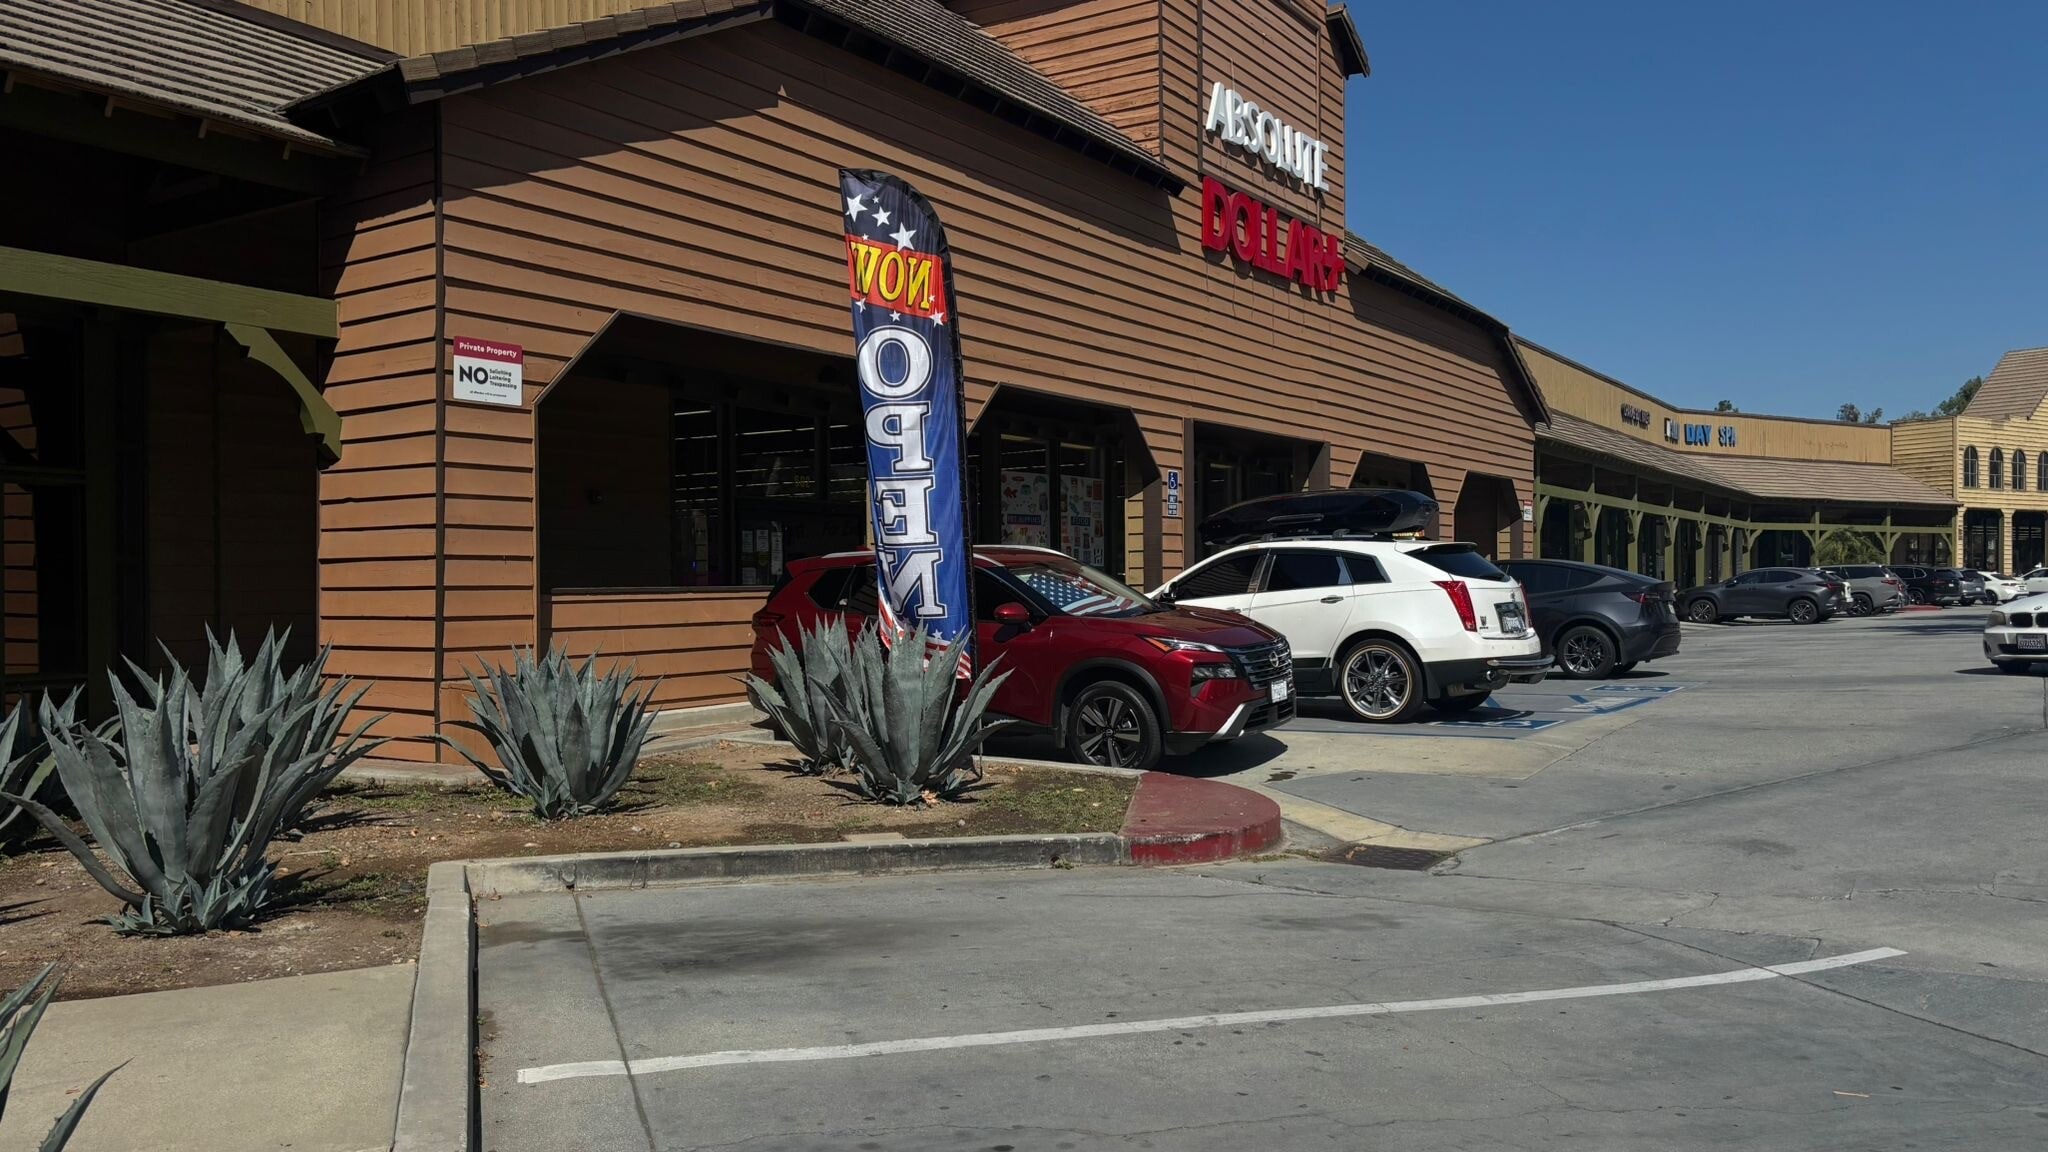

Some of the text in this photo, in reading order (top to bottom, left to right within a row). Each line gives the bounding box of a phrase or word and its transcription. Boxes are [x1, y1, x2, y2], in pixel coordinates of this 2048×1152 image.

[1206, 81, 1329, 192] ABSOLUTE
[459, 342, 517, 359] Private Property
[459, 365, 488, 385] NO
[1685, 423, 1711, 446] DAY
[1719, 425, 1737, 447] SPA
